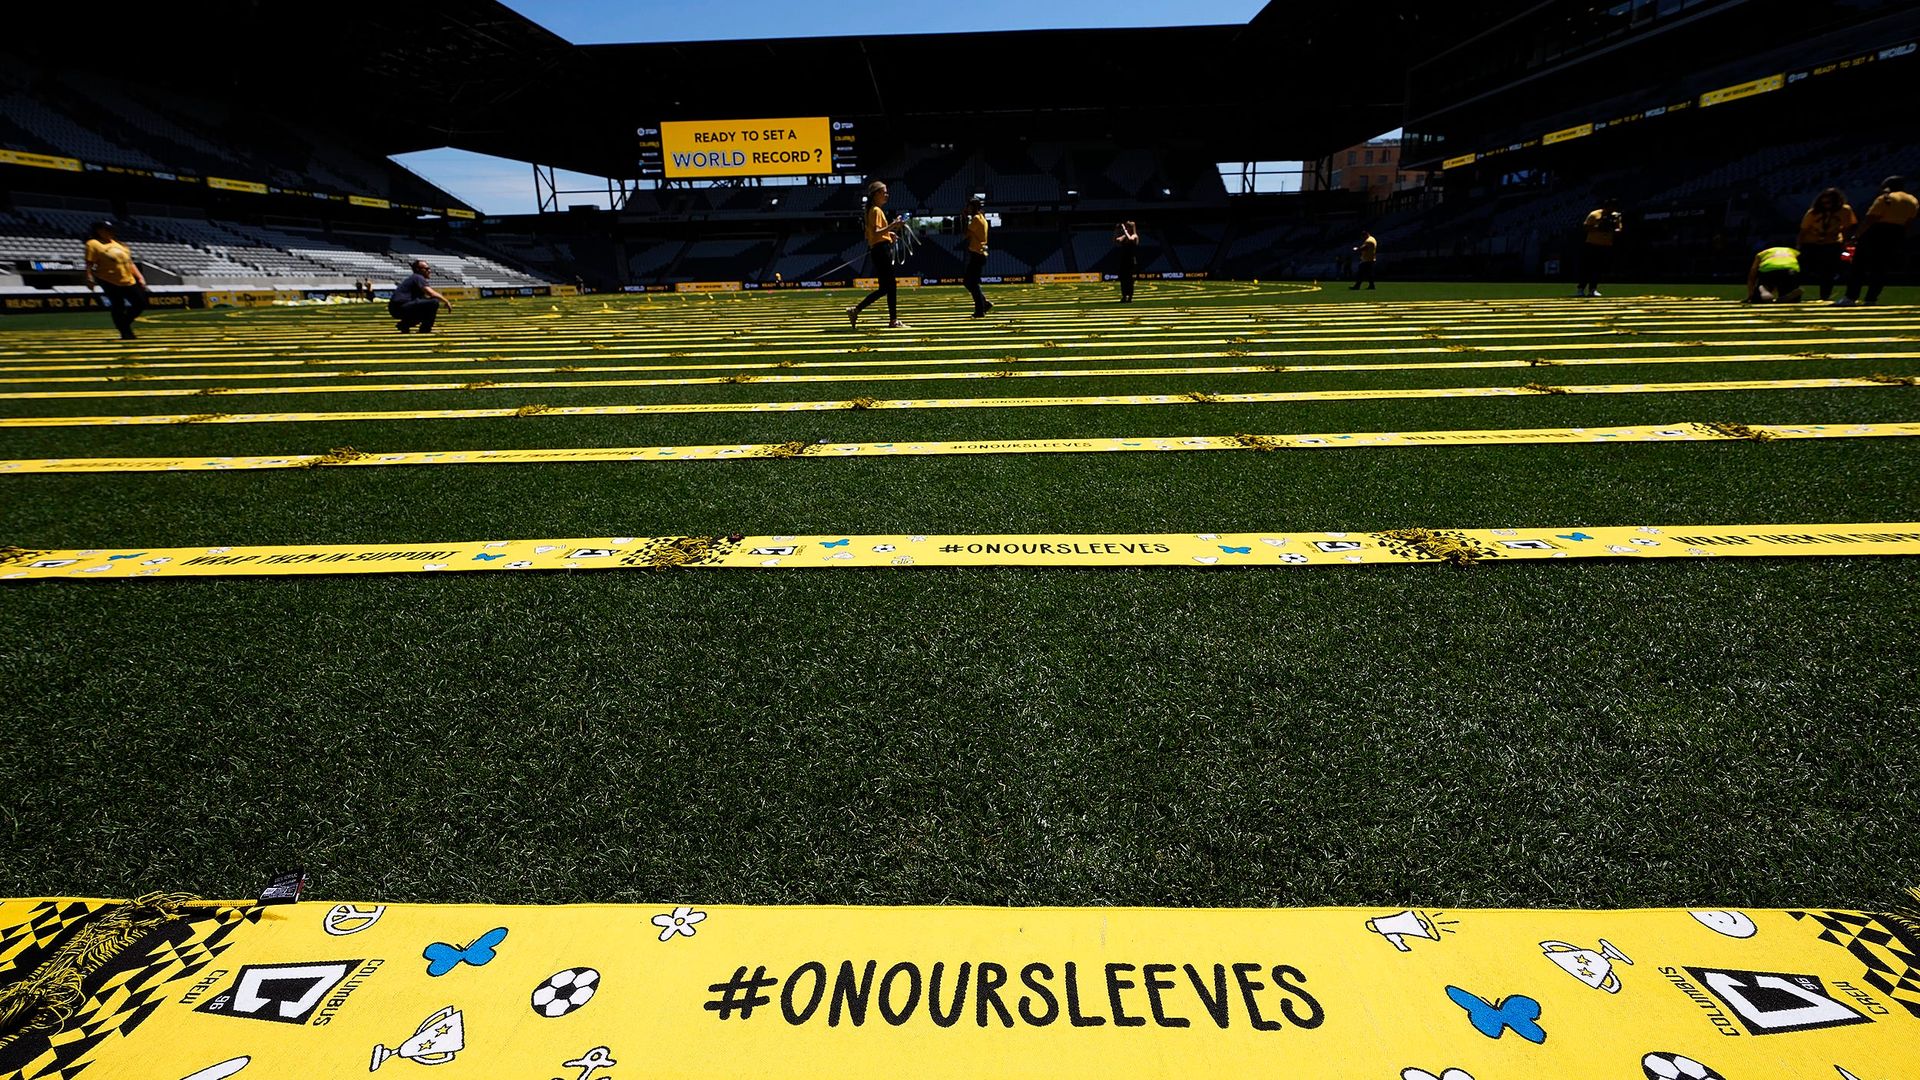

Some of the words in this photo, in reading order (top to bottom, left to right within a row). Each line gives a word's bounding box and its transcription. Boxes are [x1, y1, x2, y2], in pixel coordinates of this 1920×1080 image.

[694, 131, 736, 143] READY
[741, 130, 759, 141] TO
[763, 129, 785, 140] SET
[788, 129, 797, 140] A
[672, 150, 746, 169] WORLD
[752, 150, 810, 164] RECORD
[49, 299, 64, 308] TO
[89, 298, 98, 306] A
[1669, 534, 1752, 546] WRAP
[1749, 533, 1822, 545] THEM
[938, 543, 1171, 555] #ONOURSLEEVES
[179, 555, 261, 567] WRAP
[255, 553, 327, 565] THEM
[319, 552, 355, 563] IN
[347, 550, 462, 562] SUPPORT
[178, 968, 229, 1006] CREW
[312, 957, 385, 1027] COLUMBUS
[703, 959, 1327, 1031] #ONOURSLEEVES
[208, 994, 232, 1012] 96
[1657, 965, 1741, 1038] COLUMBUS
[1830, 980, 1890, 1017] CREW
